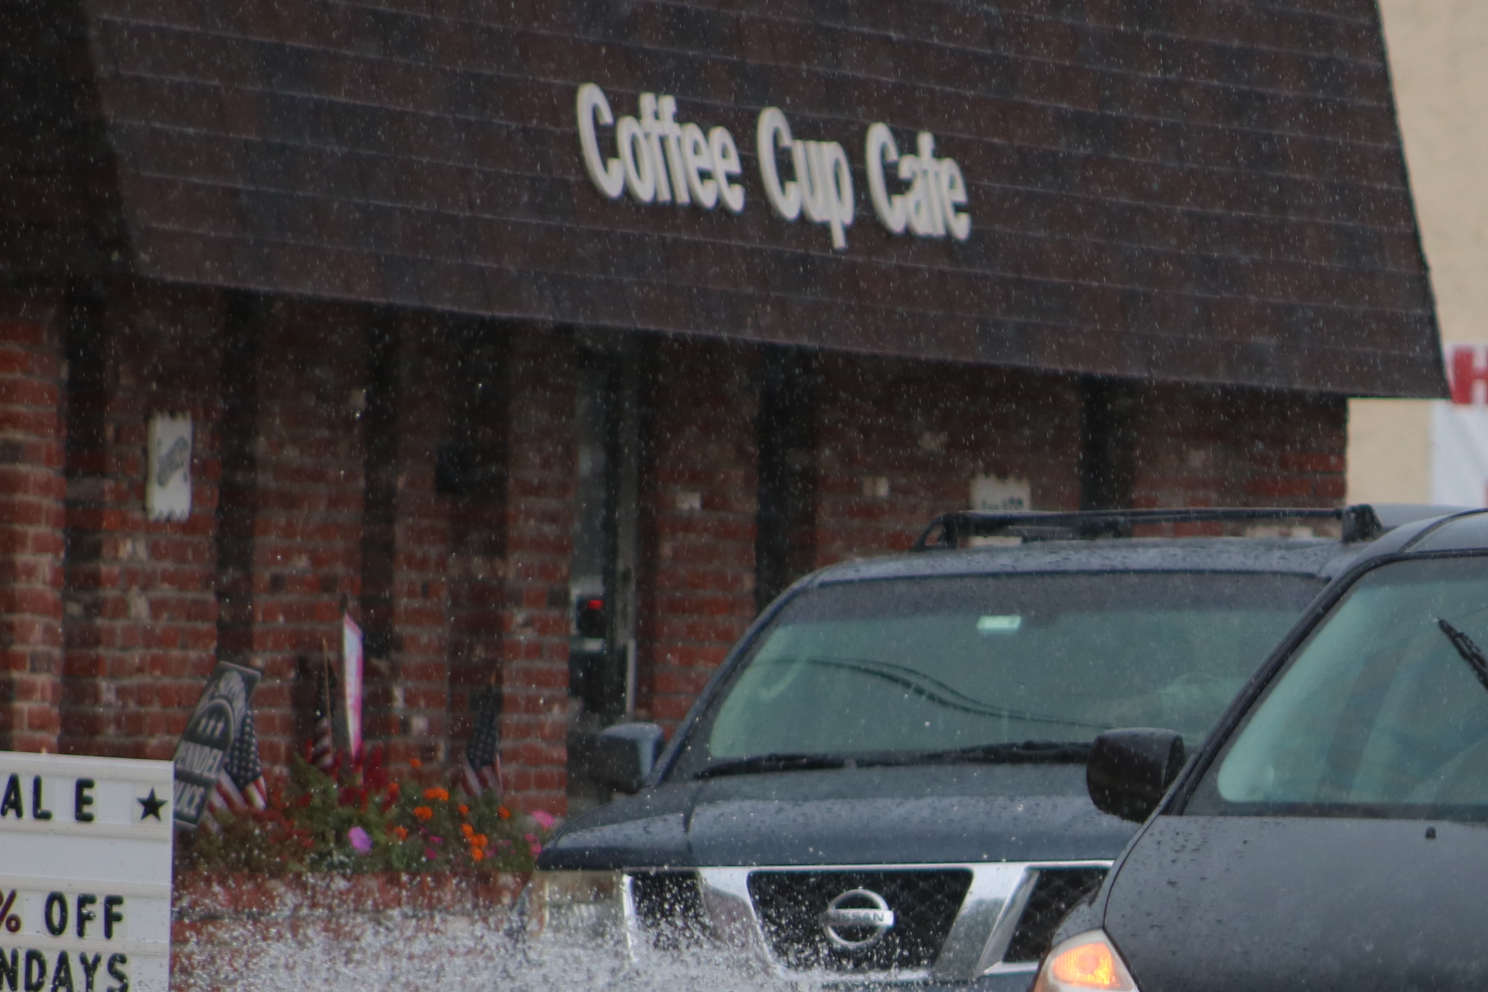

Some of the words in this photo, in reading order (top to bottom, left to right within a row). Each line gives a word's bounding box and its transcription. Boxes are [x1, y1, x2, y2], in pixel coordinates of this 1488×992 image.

[577, 82, 745, 213] Coffee
[757, 106, 856, 250] Cup
[866, 122, 971, 241] Cafe
[44, 891, 124, 939] OFF
